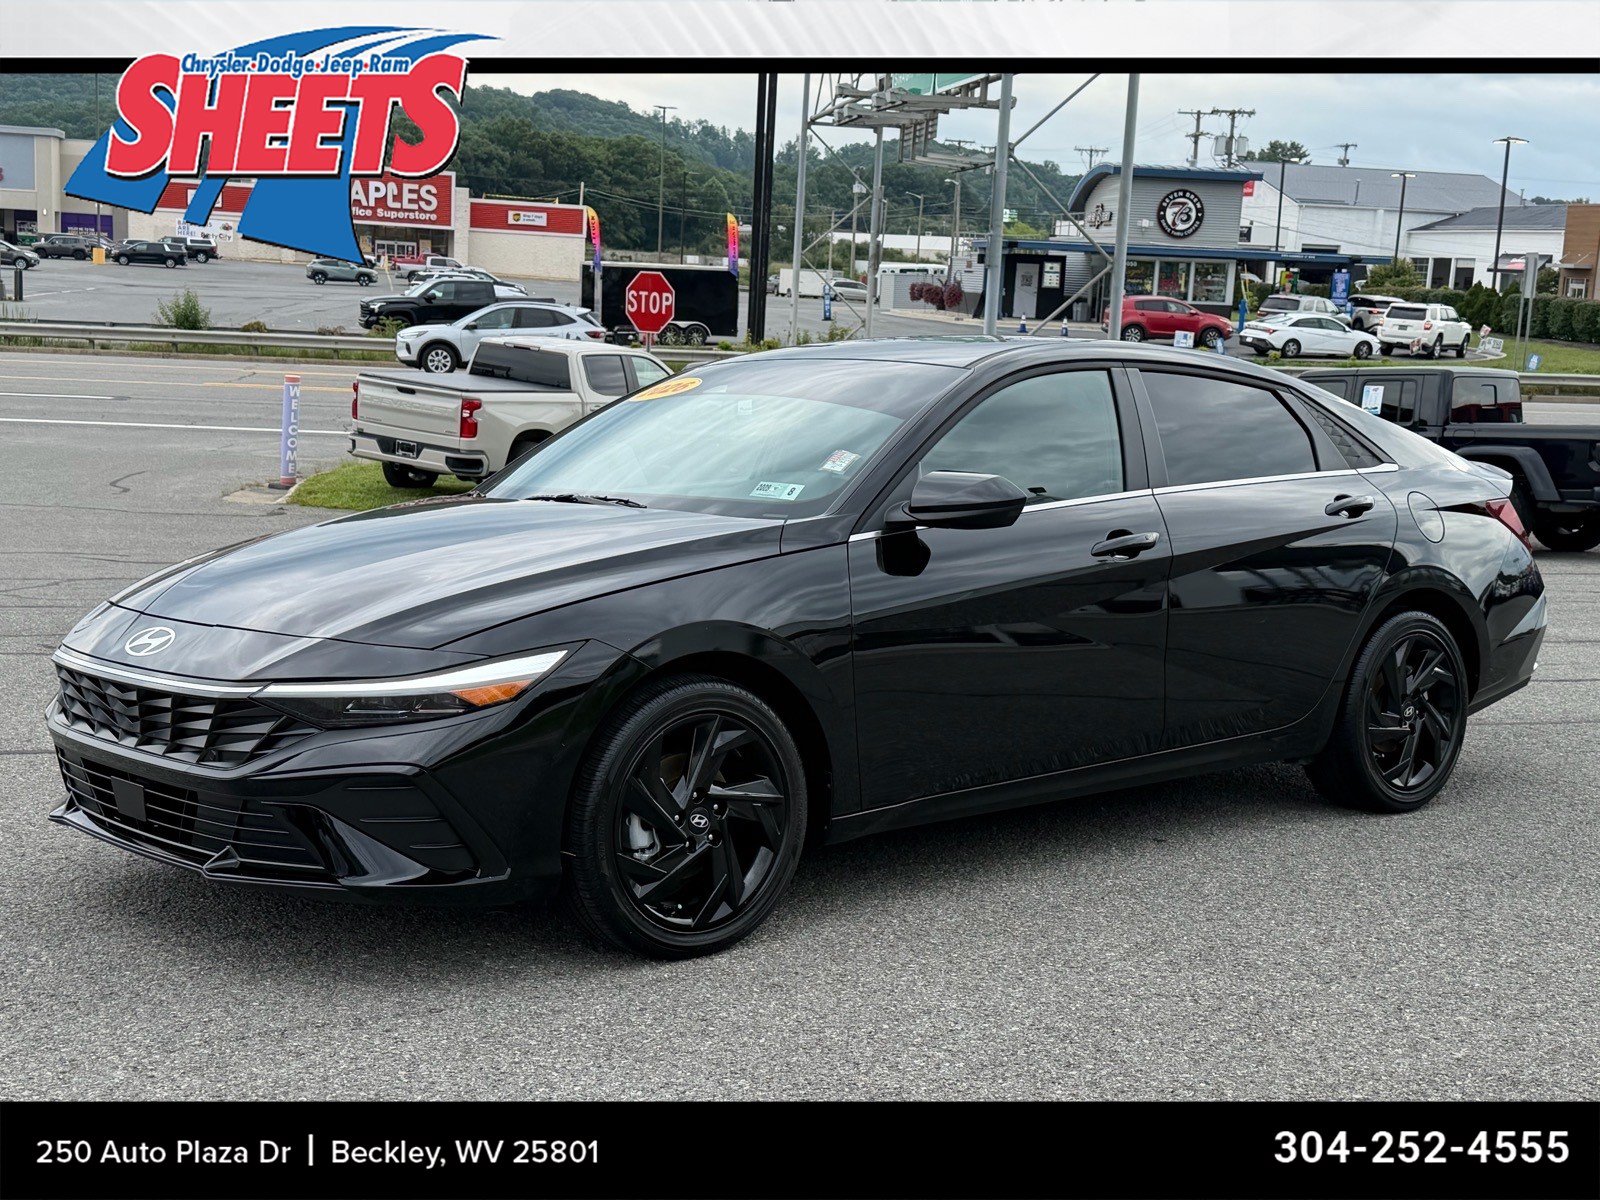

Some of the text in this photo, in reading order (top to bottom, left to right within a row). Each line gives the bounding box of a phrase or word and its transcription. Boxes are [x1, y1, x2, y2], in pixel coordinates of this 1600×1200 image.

[351, 180, 438, 211] APLES
[1162, 191, 1202, 209] SEVEN BREW
[377, 208, 437, 221] Superstore
[628, 290, 673, 315] STOP
[285, 385, 301, 475] WELCOME
